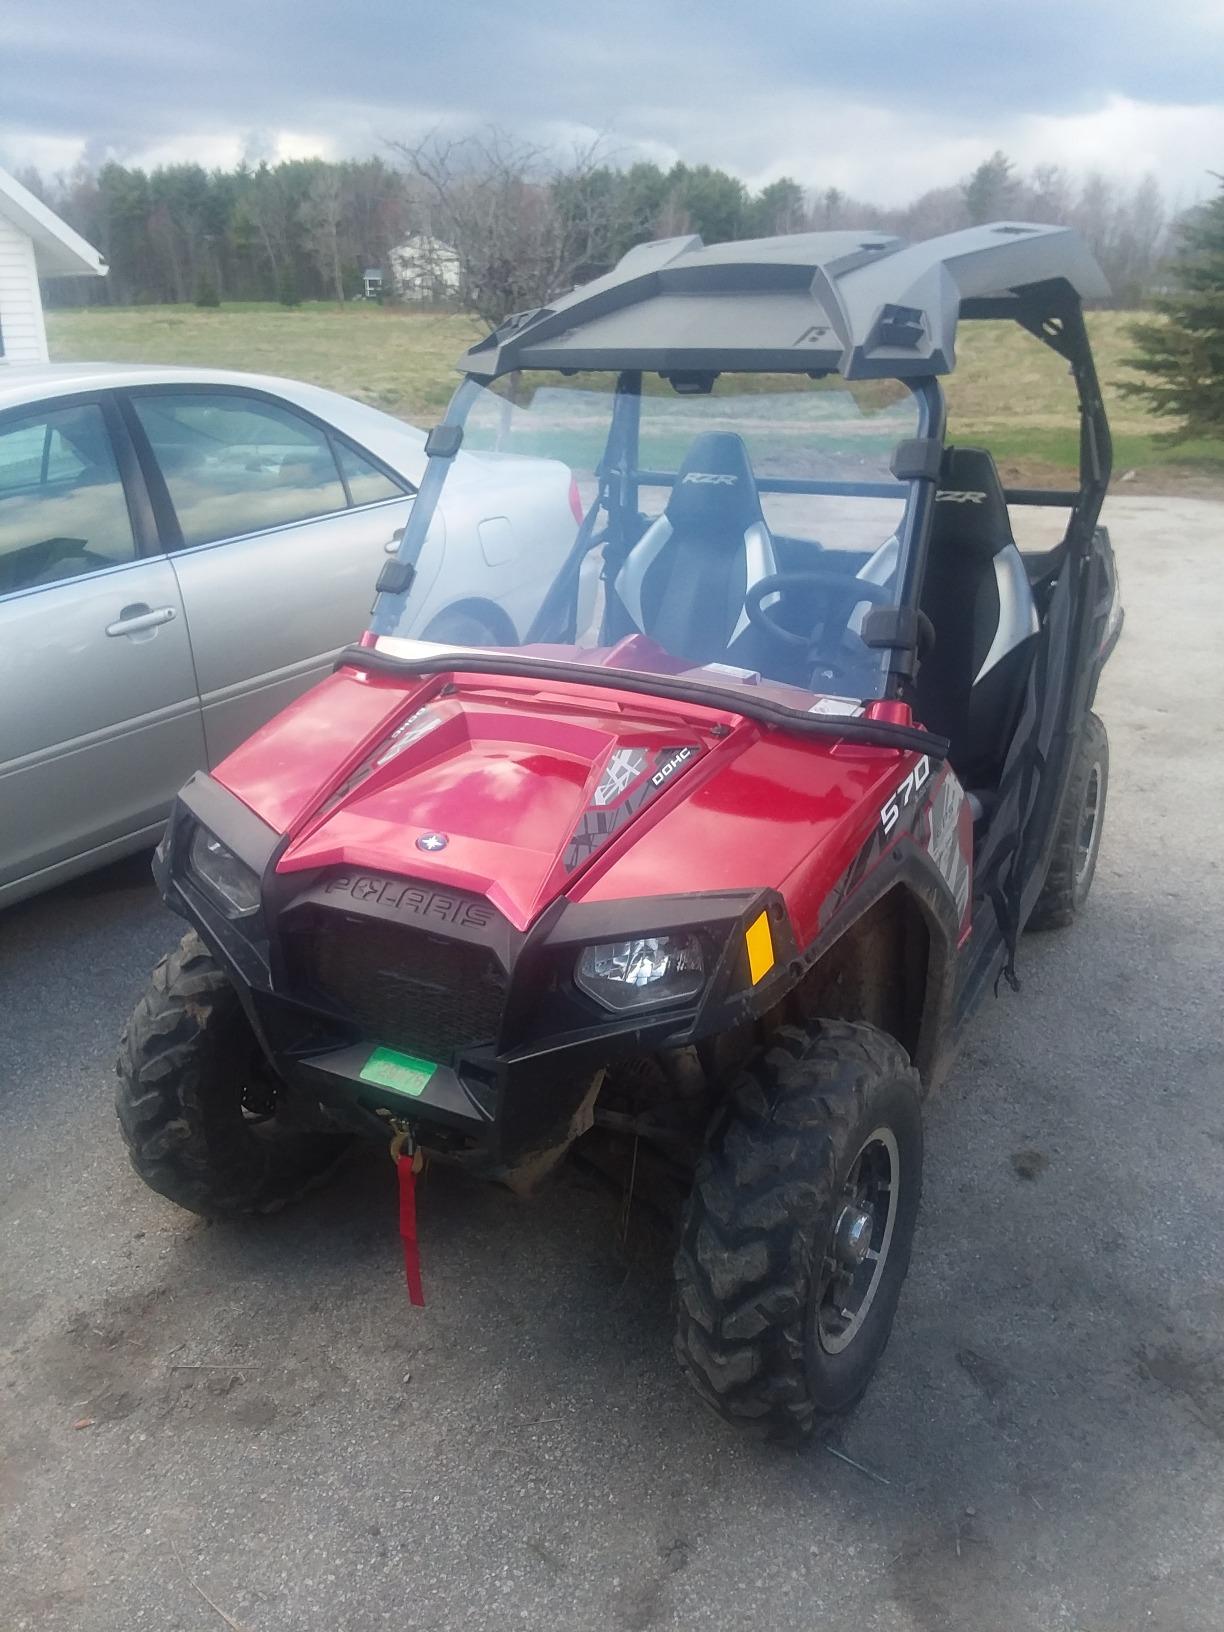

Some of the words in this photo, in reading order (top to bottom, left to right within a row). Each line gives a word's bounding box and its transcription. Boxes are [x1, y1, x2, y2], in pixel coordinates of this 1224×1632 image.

[651, 747, 691, 786] DOHC
[880, 754, 930, 835] 570
[325, 876, 495, 928] POLARIS
